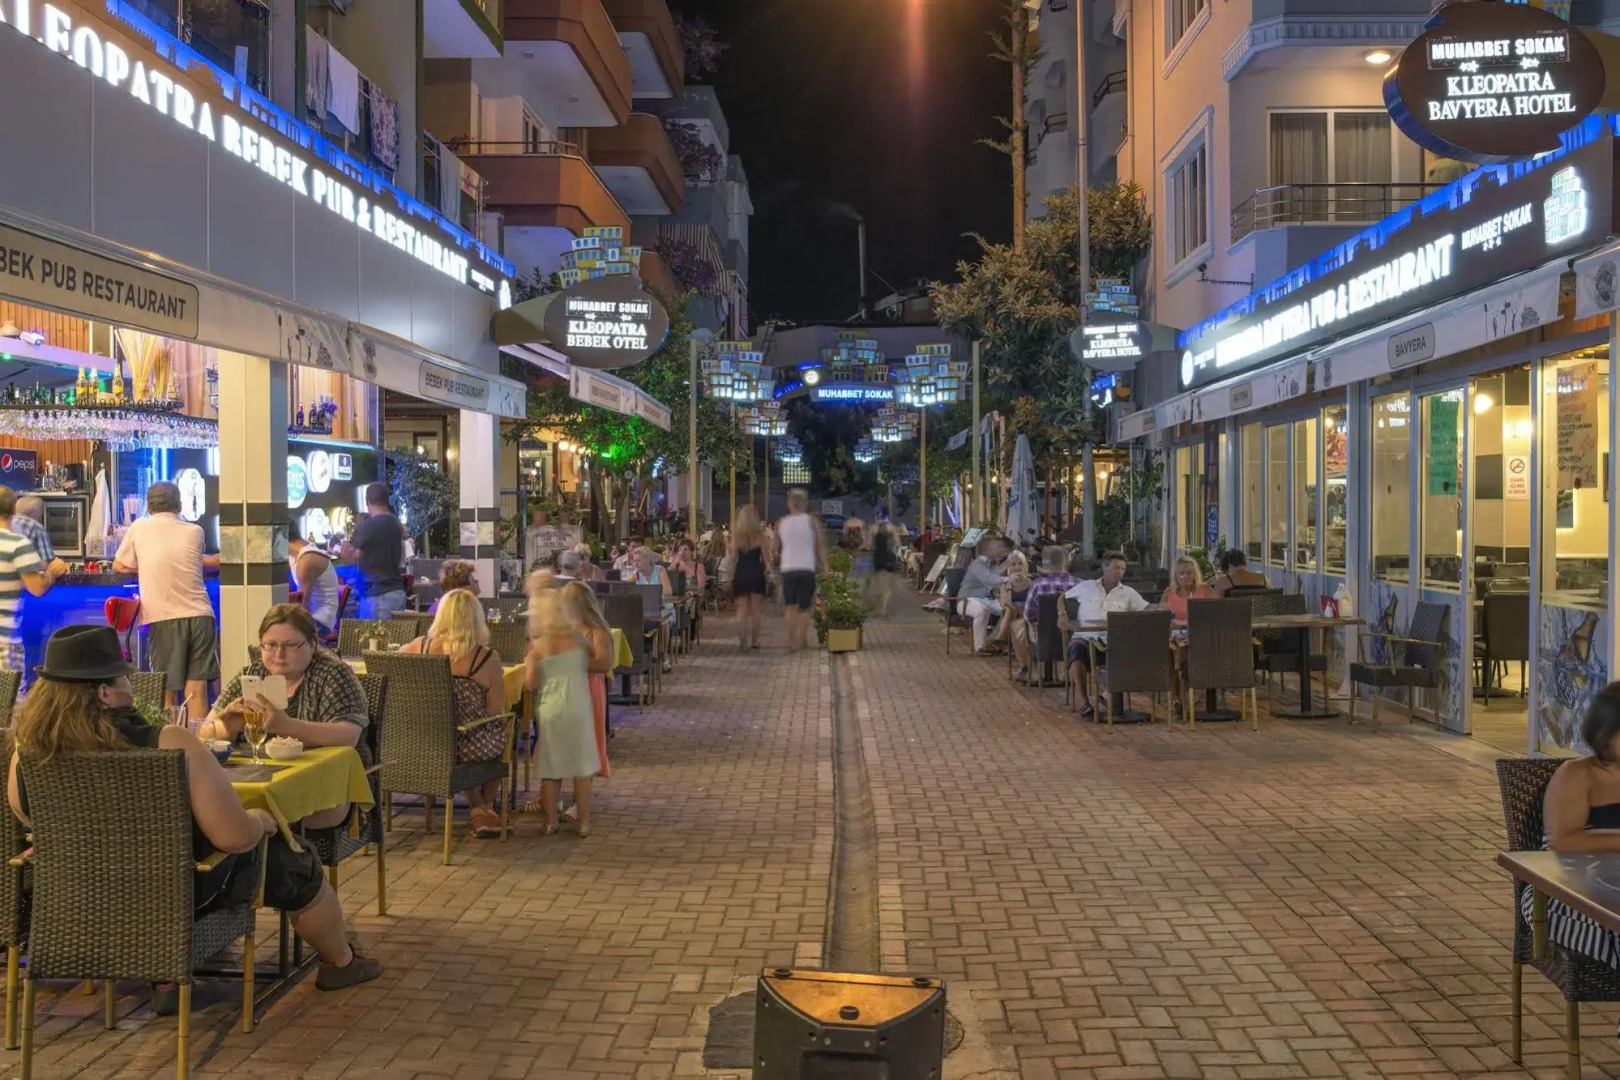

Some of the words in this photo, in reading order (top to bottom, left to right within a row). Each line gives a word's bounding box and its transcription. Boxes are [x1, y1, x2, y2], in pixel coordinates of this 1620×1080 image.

[1431, 40, 1510, 60] MUHABBET
[1515, 36, 1566, 56] SOKAK
[1446, 71, 1556, 96] KLEOPATRA
[1428, 97, 1512, 121] BAVYERA
[1514, 93, 1577, 116] HOTEL
[222, 115, 309, 197] BEBEK
[312, 168, 355, 223] PUB
[357, 197, 373, 233] &
[374, 205, 469, 285] RESTAURANT
[1461, 216, 1502, 250] MUHABBET
[1503, 202, 1532, 233] SOKAK
[1349, 233, 1454, 314] RESTAURANT
[41, 258, 77, 292] PUB
[83, 270, 187, 320] RESTAURANT
[568, 300, 617, 313] MUHABBET
[618, 302, 649, 314] SOKAK
[568, 320, 647, 336] KLEOPATRA
[566, 334, 611, 348] BEBEK
[613, 336, 648, 350] OTEL
[1395, 340, 1427, 358] BAVYERA
[425, 372, 444, 389] BEBEK
[443, 378, 455, 393] PUB
[454, 381, 485, 399] RESTAURANT
[818, 388, 863, 399] MUHABBET
[864, 389, 894, 399] SOKAK
[14, 459, 35, 470] pepsi
